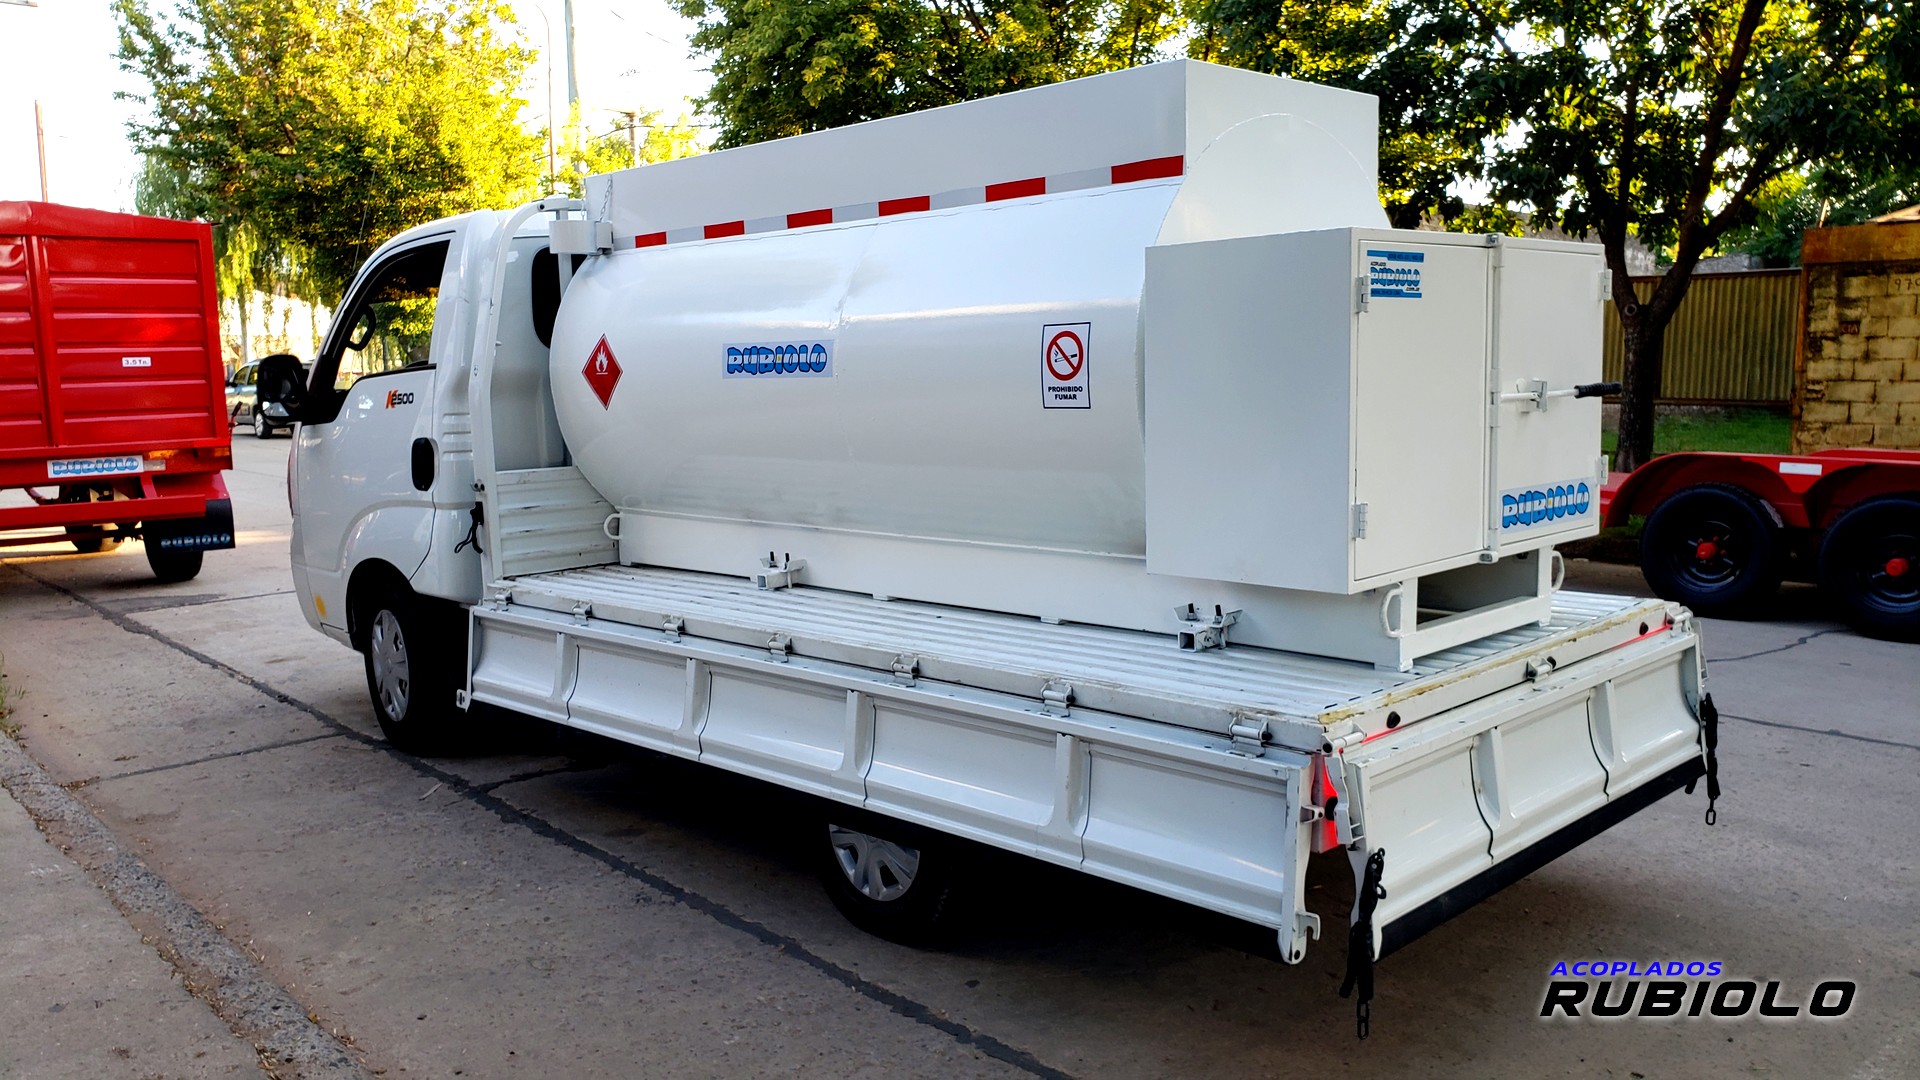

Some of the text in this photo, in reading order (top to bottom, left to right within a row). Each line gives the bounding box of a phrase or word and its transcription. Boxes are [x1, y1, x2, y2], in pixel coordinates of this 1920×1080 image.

[1370, 267, 1420, 287] RUBIOLO
[727, 344, 827, 375] RUBIOLO
[386, 390, 414, 409] K2500
[52, 457, 139, 475] RUBIOLO
[1502, 482, 1590, 529] RUBIOLO
[161, 533, 231, 548] RUBIOLO
